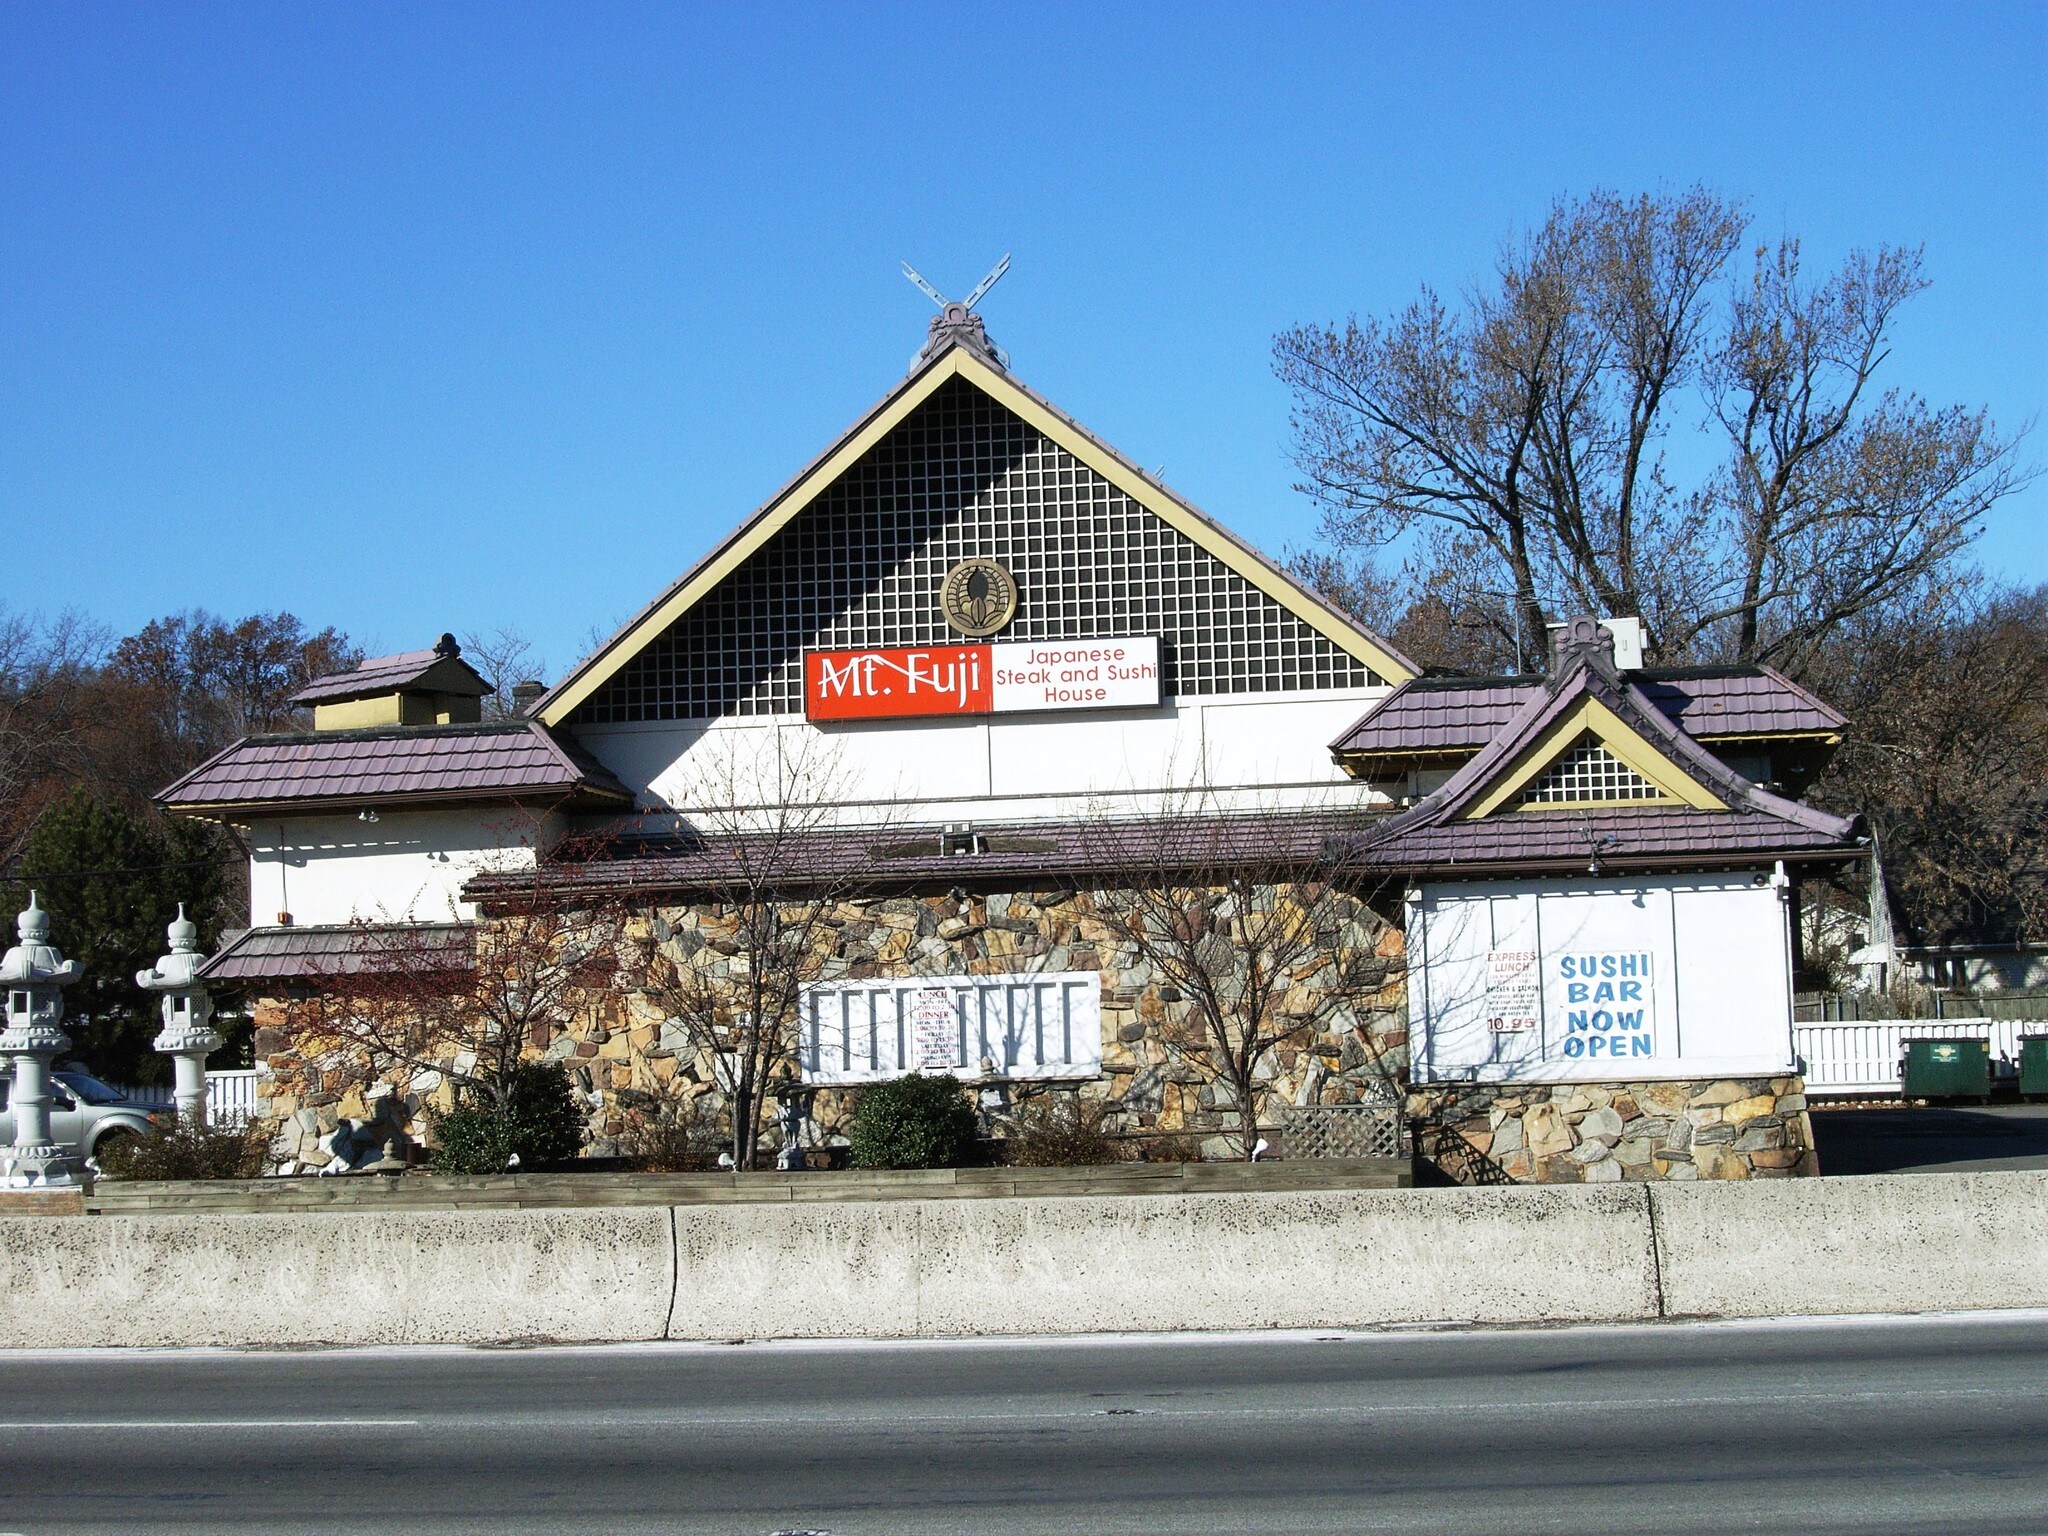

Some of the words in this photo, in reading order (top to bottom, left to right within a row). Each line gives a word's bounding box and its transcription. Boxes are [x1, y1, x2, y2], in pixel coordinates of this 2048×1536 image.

[1027, 648, 1126, 666] Japanese
[817, 654, 893, 699] Mt.
[907, 652, 980, 708] Fuji
[996, 665, 1051, 686] Steak
[1060, 664, 1099, 683] and
[1108, 663, 1157, 681] Sushi
[1045, 687, 1107, 703] House
[1487, 951, 1536, 962] EXPRESS
[1560, 953, 1648, 979] SUSHI
[1495, 962, 1530, 972] LUNCH
[919, 990, 947, 999] LUNCH
[1568, 980, 1643, 1004] BAR
[1487, 1018, 1536, 1030] 10.95
[1568, 1008, 1644, 1033] NOW
[1563, 1033, 1652, 1058] OPEN
